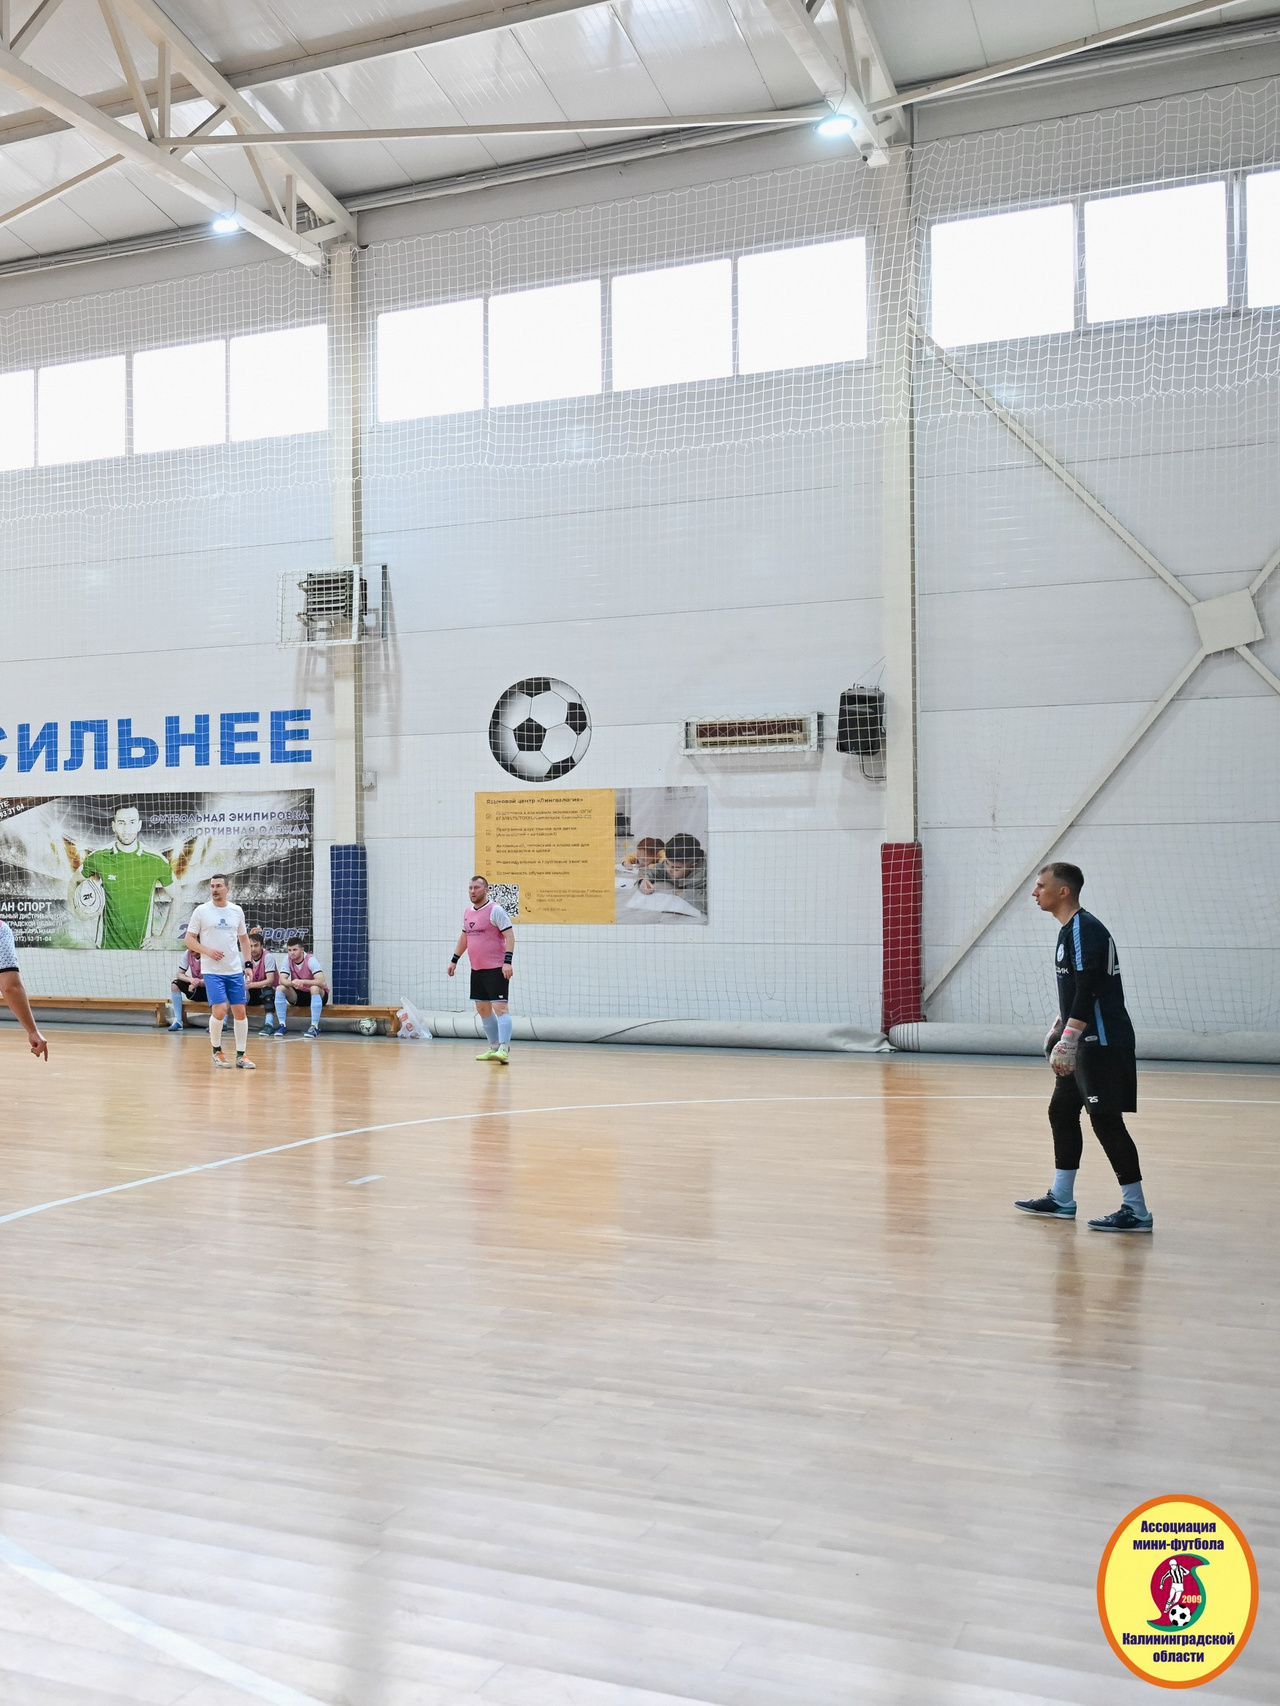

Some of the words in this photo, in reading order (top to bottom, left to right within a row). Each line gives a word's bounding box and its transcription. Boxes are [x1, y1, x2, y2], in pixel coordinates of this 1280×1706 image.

[0, 810, 8, 819] 93
[150, 812, 225, 825] ФУТБОЛЬНАЯ
[229, 810, 309, 822] ЭКИПИРОВКА
[179, 826, 257, 837] СПОРТИВНАЯ
[259, 824, 310, 835] ОДЕЖДА
[230, 838, 309, 850] АКСЕССУАРЫ
[17, 902, 52, 912] СПОРТ
